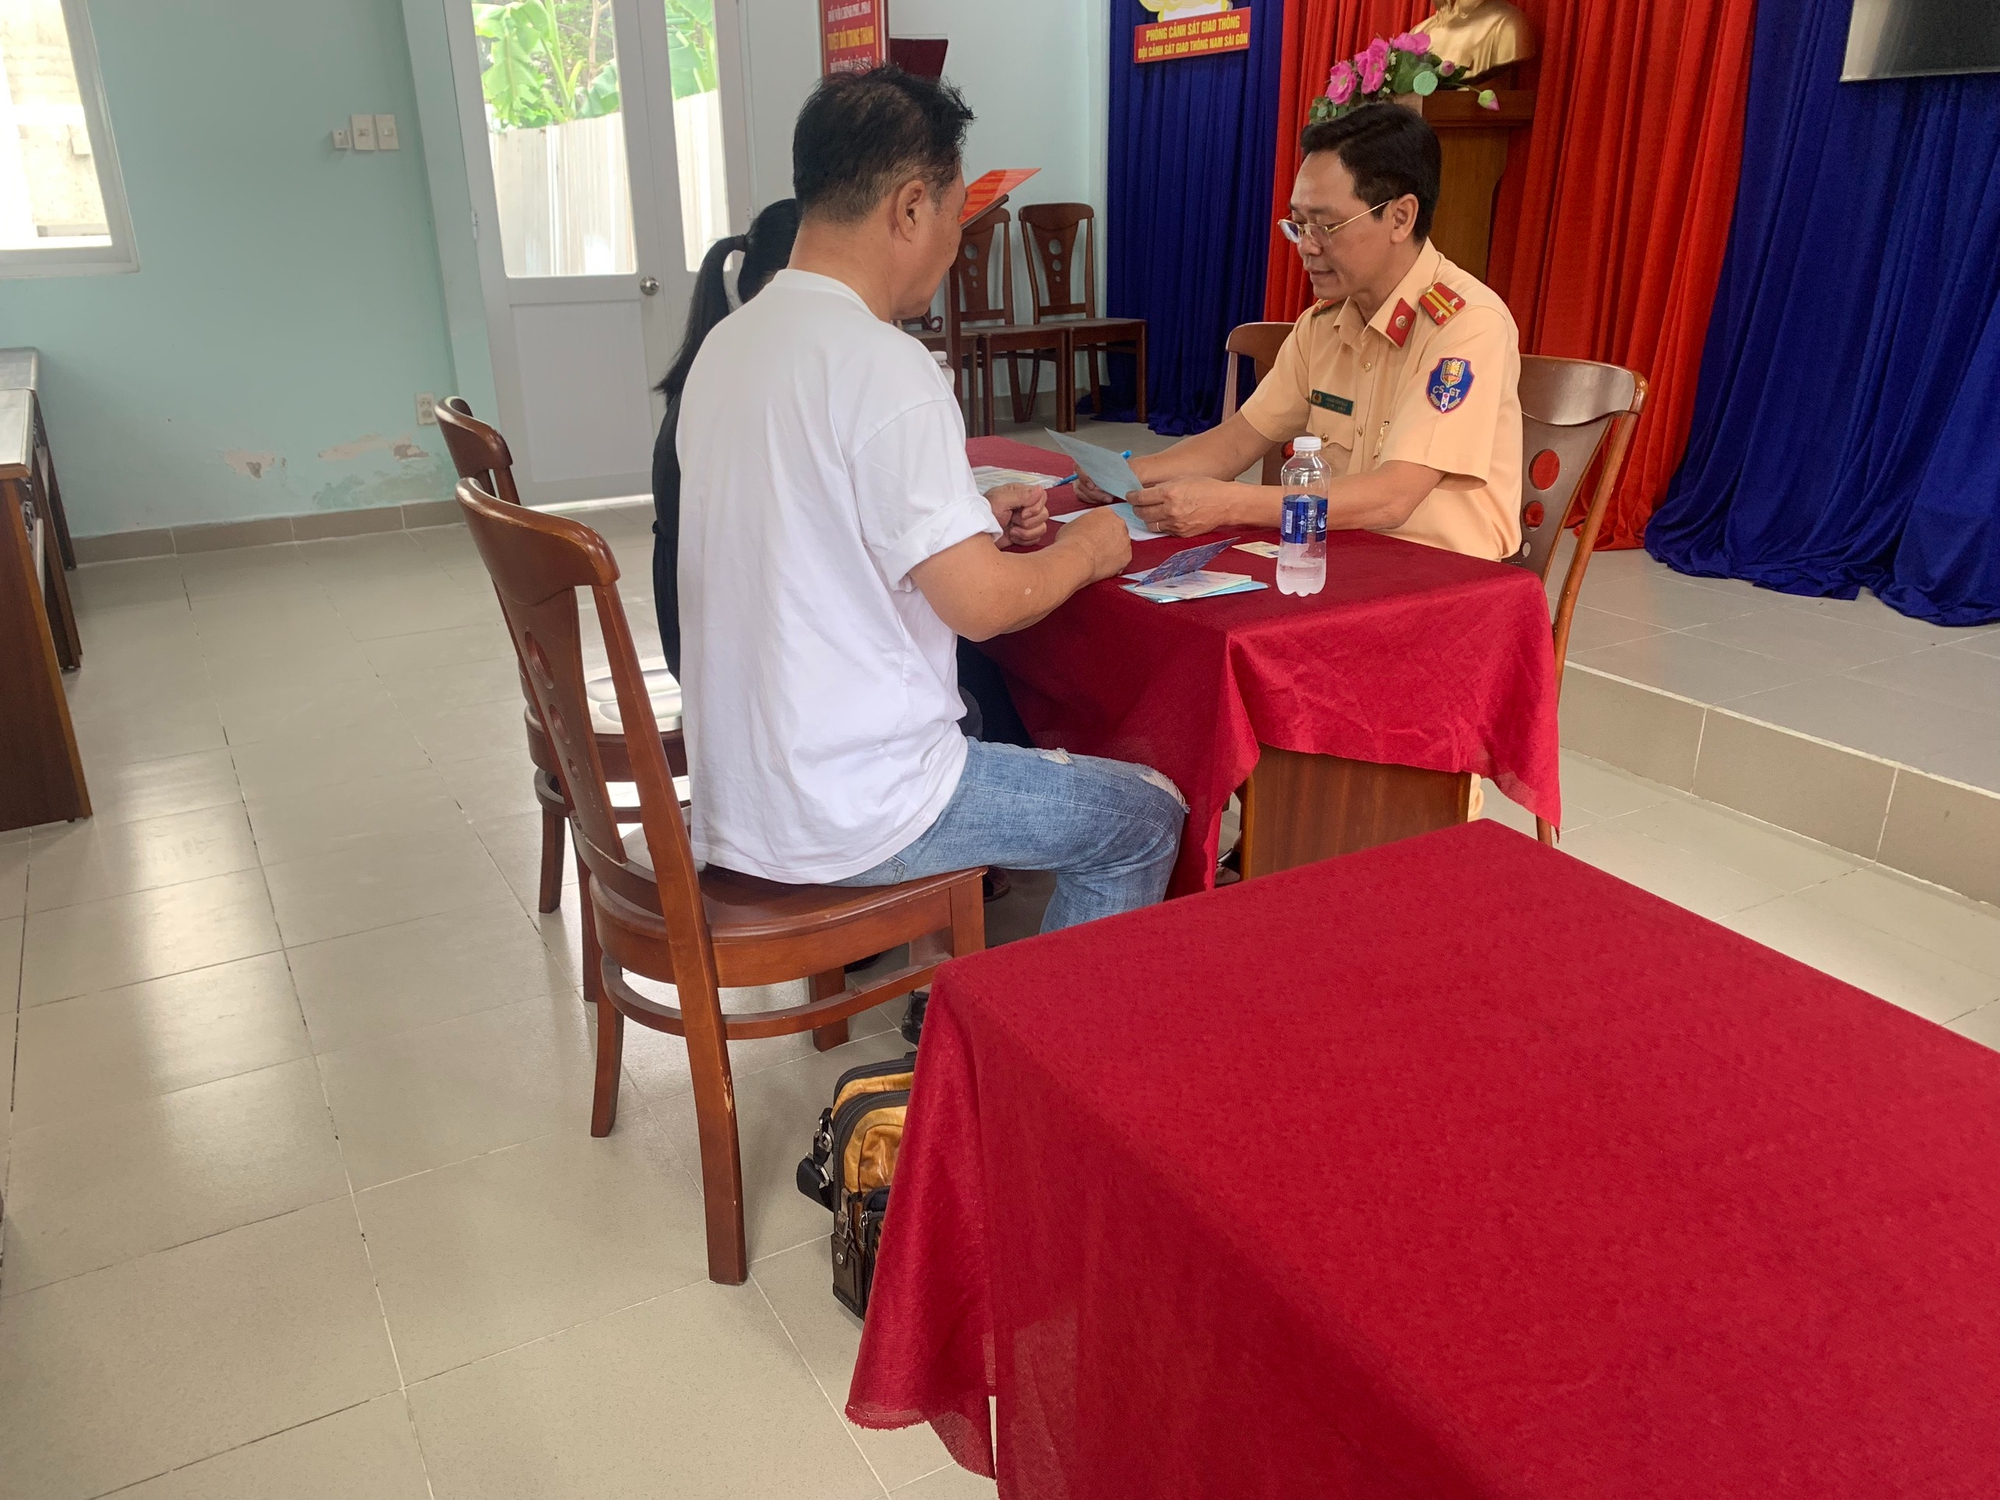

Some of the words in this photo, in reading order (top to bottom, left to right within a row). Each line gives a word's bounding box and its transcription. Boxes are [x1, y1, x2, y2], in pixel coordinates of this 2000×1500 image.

[1146, 26, 1167, 42] PHÒNG
[1169, 22, 1186, 37] CẢNH
[1188, 20, 1200, 35] SÁT
[1201, 21, 1216, 34] GIAO
[1218, 15, 1240, 31] THÔNG
[1148, 42, 1163, 57] CẢNH
[1164, 41, 1175, 55] SÁT
[1176, 41, 1189, 53] GIAO
[1190, 37, 1208, 51] THÔNG
[1210, 36, 1223, 48] NAM
[1224, 33, 1235, 46] SÀI
[1432, 385, 1445, 394] CS
[1449, 387, 1461, 397] GT
